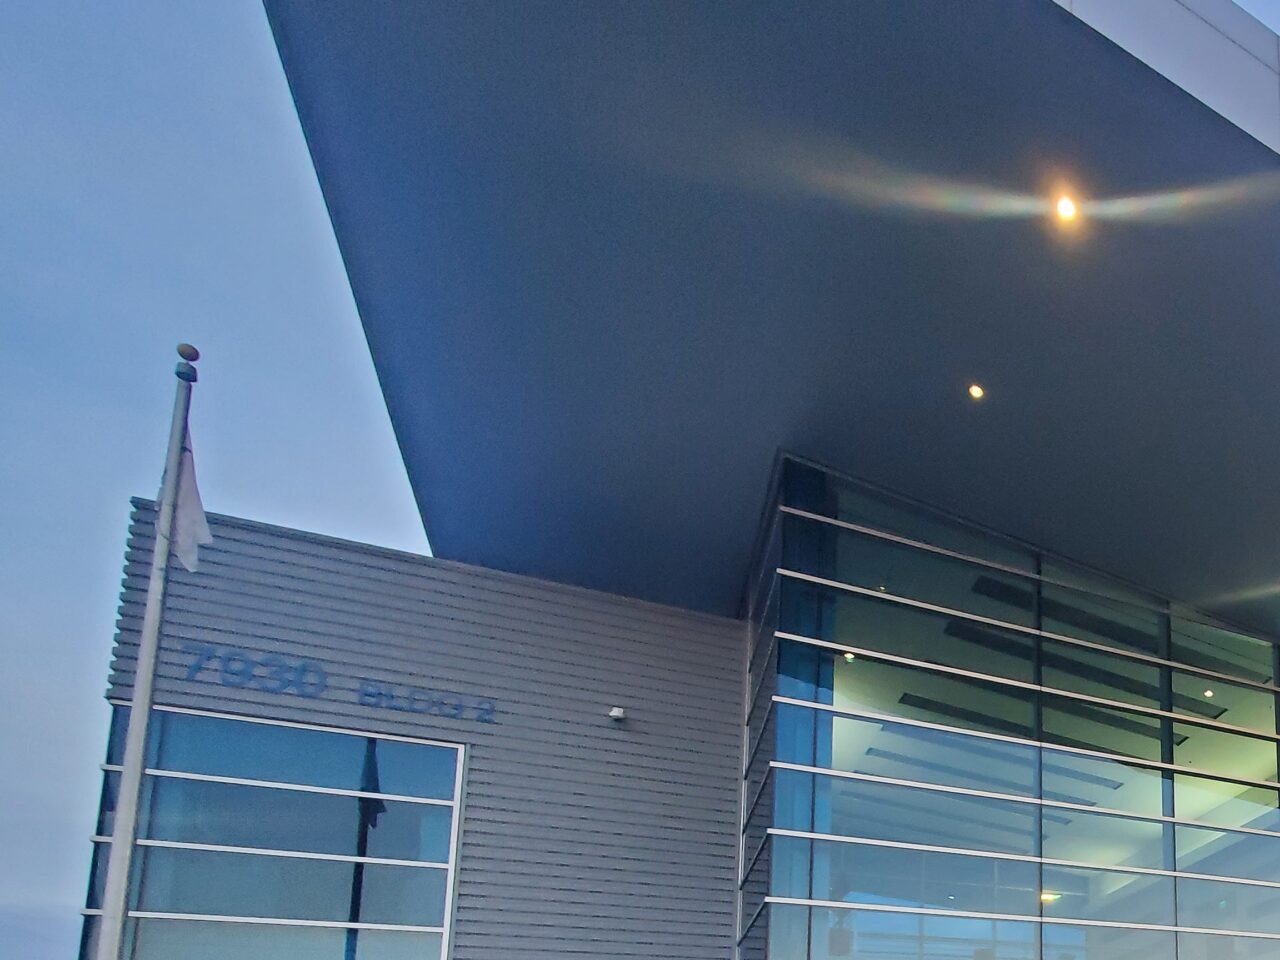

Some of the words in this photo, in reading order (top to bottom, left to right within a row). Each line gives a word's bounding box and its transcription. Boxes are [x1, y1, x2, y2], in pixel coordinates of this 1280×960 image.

[179, 643, 327, 698] 7930
[358, 680, 464, 720] BLDG
[475, 700, 496, 724] 2
